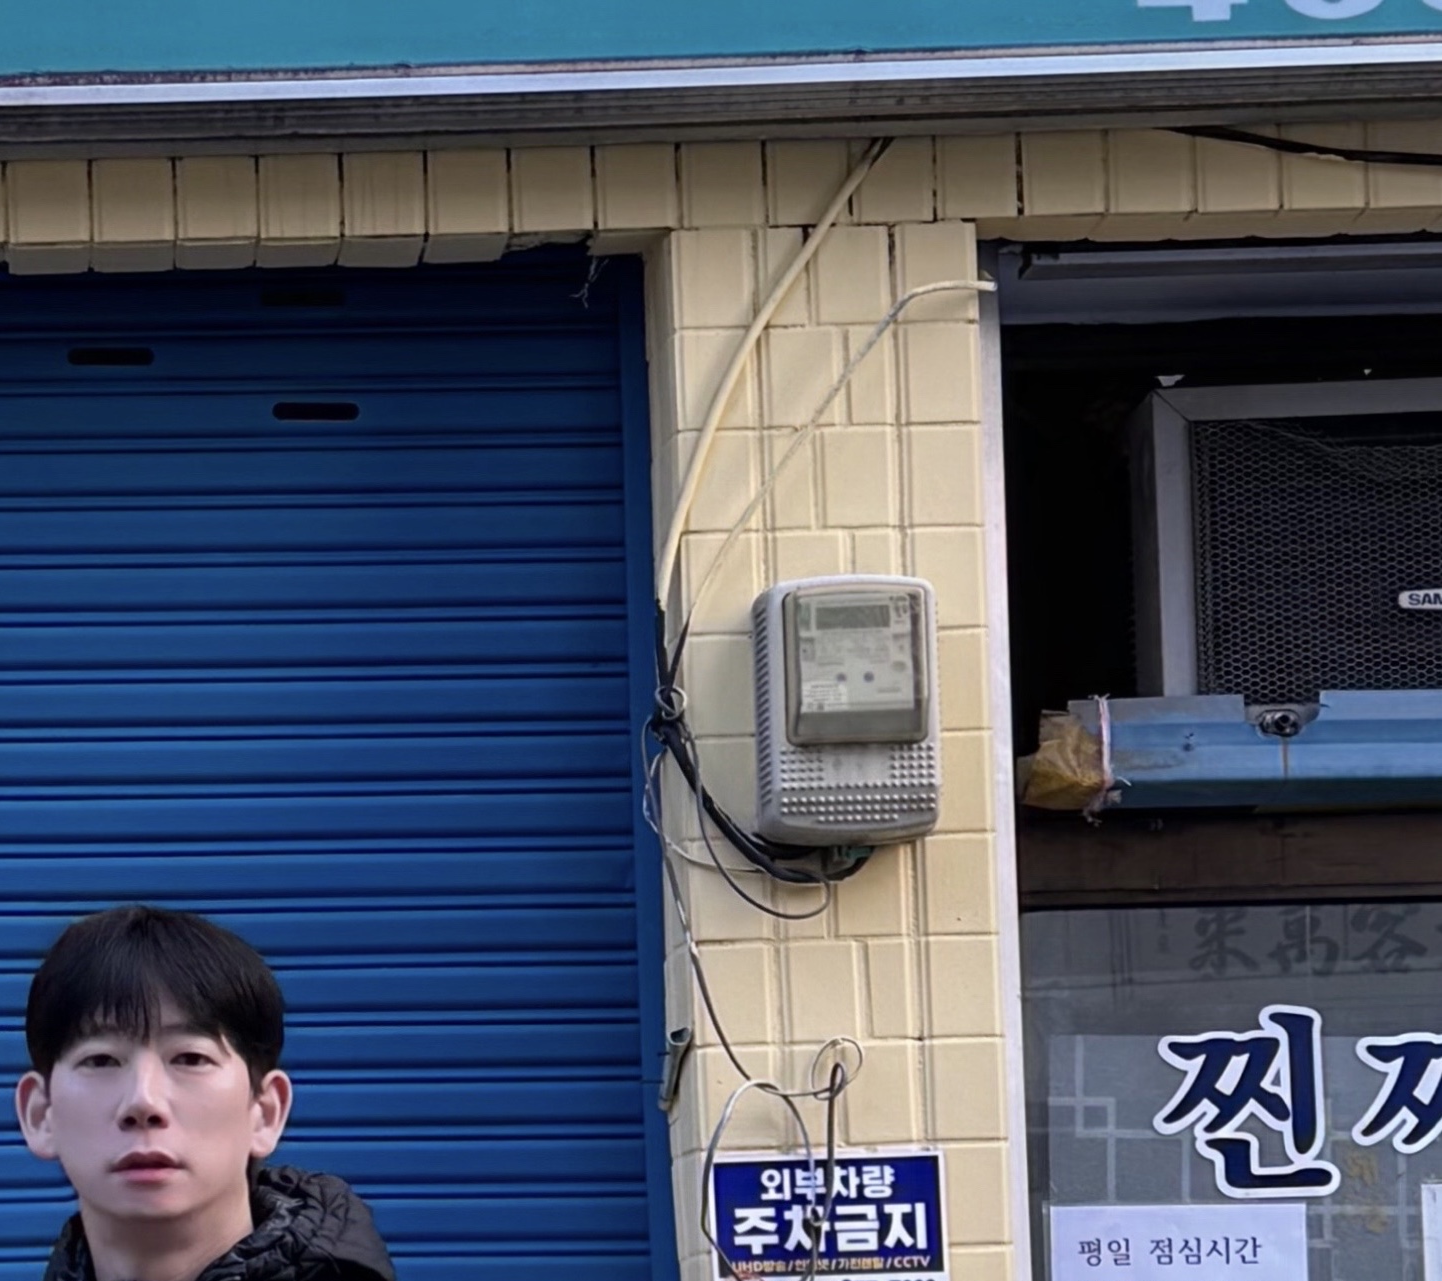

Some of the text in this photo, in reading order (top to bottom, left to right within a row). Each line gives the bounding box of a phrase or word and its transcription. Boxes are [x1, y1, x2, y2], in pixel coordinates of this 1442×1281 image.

[760, 1165, 895, 1201] 외부차량
[733, 1202, 928, 1255] 주차금지
[1078, 1236, 1262, 1267] 평일 점심시간
